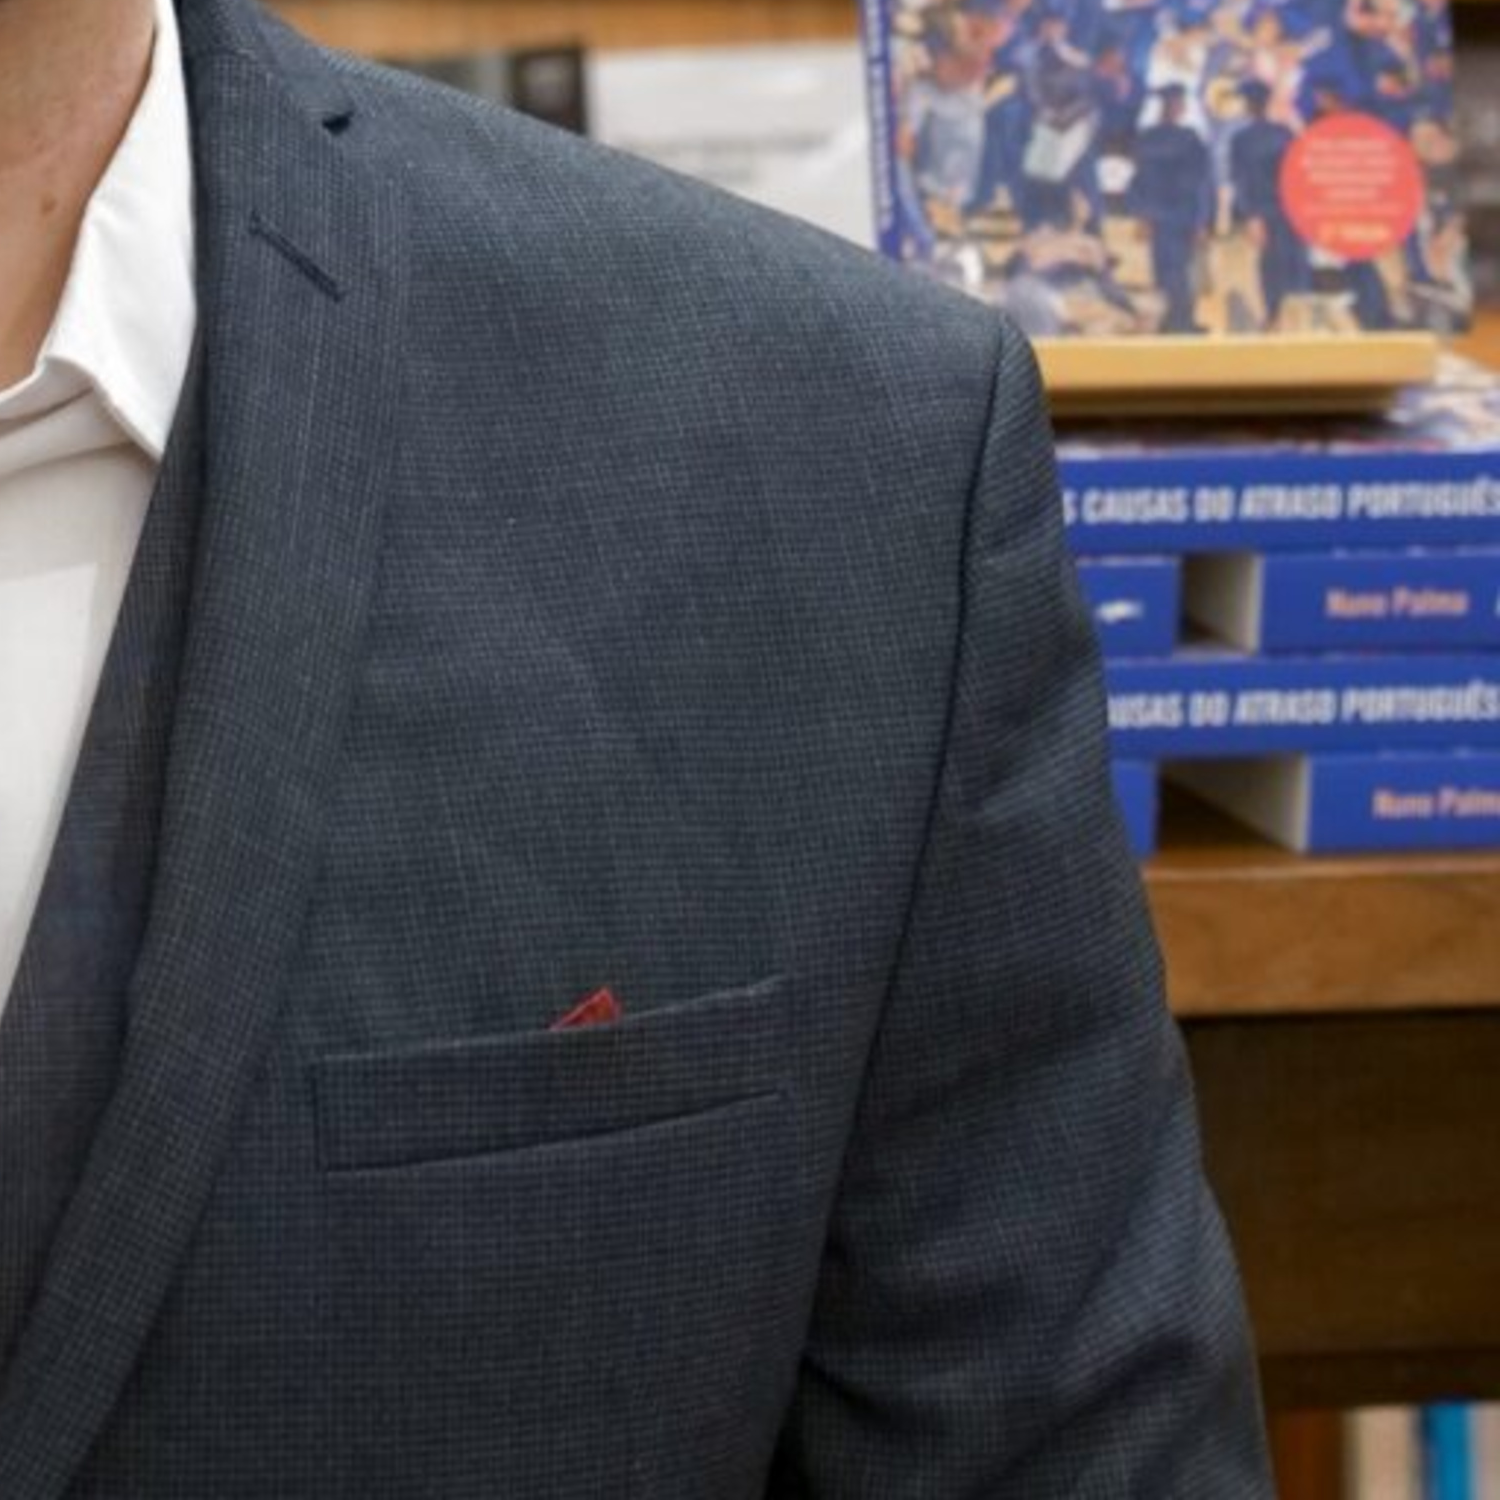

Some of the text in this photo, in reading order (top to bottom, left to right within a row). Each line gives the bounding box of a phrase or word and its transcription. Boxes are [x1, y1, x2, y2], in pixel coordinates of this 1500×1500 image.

[1082, 486, 1189, 524] CAUSAS
[1194, 485, 1235, 522] DO
[1238, 483, 1342, 521] ATRASO
[1107, 692, 1183, 729] USAS
[1188, 691, 1229, 727] DO
[1232, 688, 1336, 725] ATRASO
